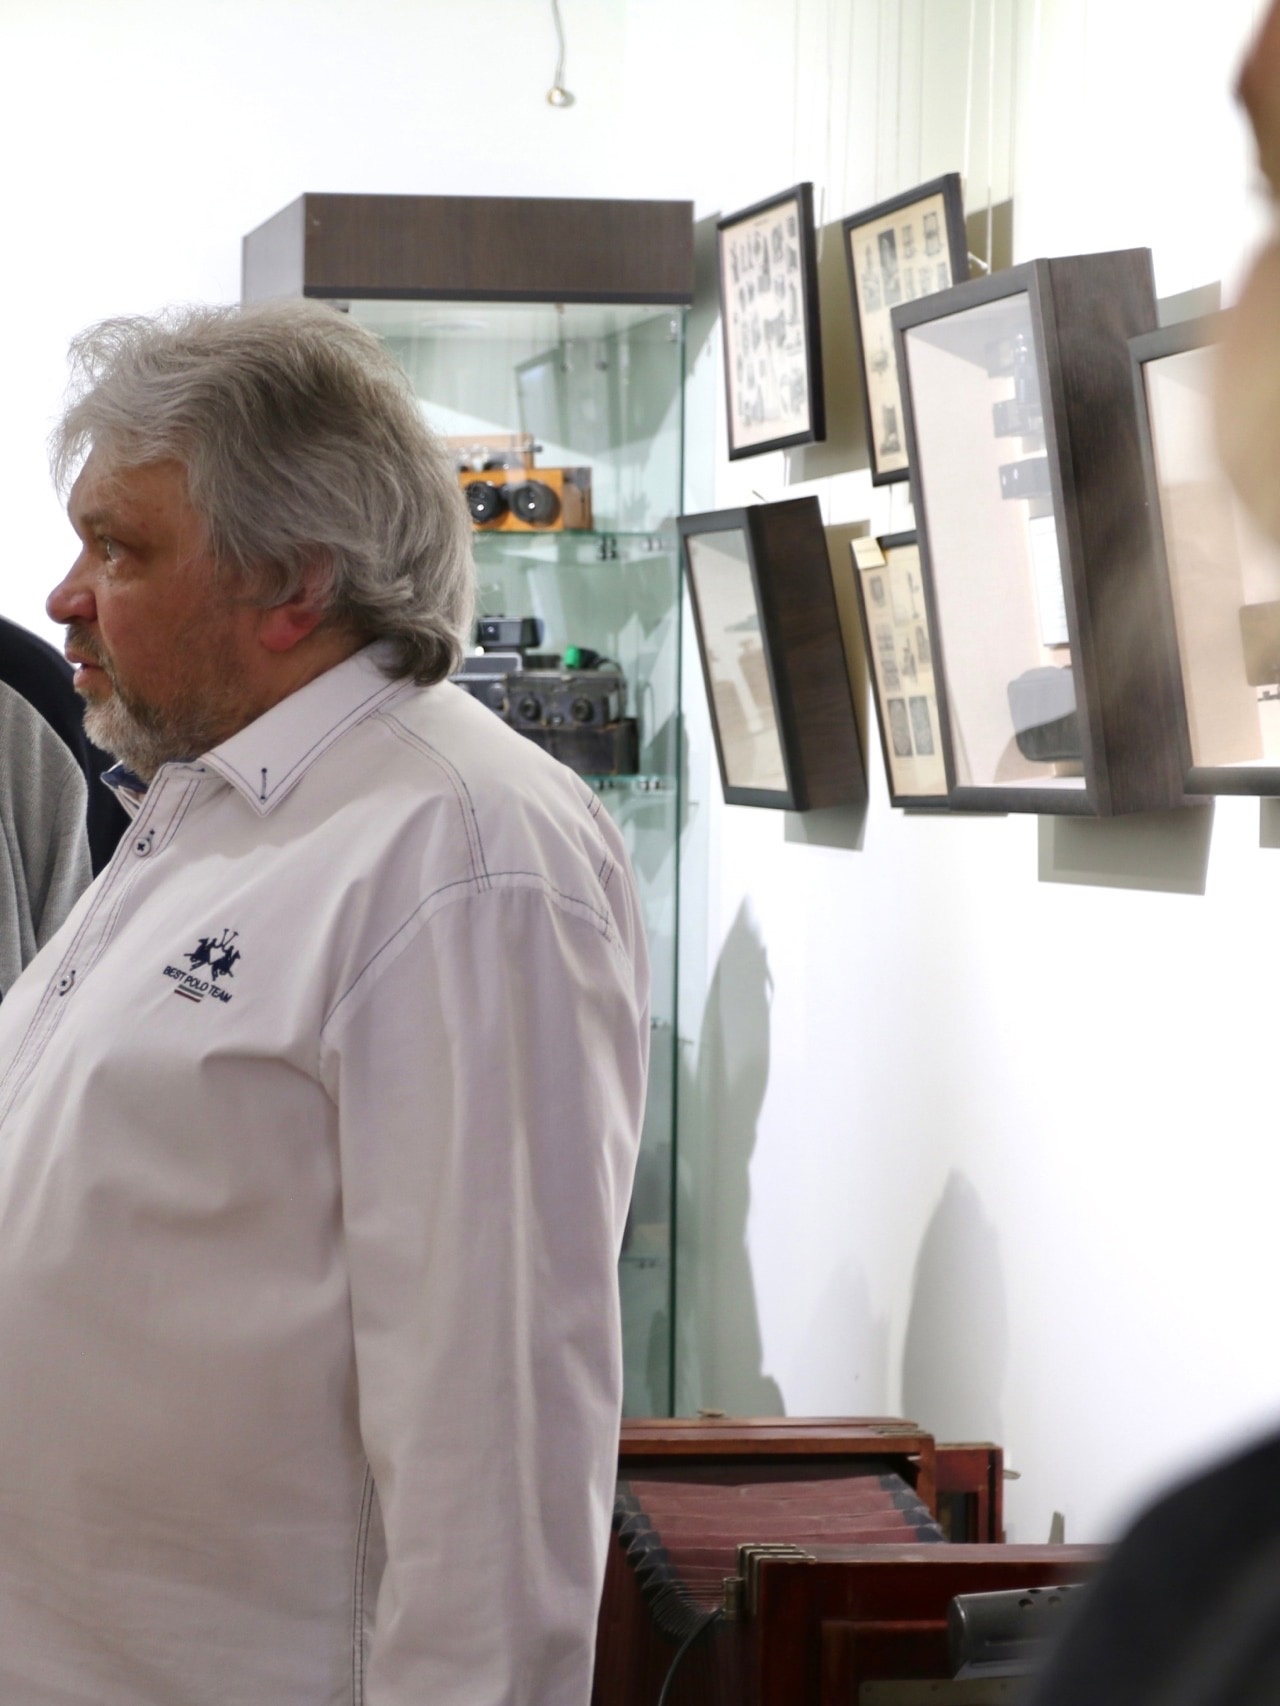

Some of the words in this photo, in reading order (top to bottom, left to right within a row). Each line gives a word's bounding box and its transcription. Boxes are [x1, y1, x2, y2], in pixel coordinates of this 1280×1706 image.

[162, 965, 187, 982] BEST
[183, 975, 209, 992] POLO
[207, 985, 233, 1004] TEAM
